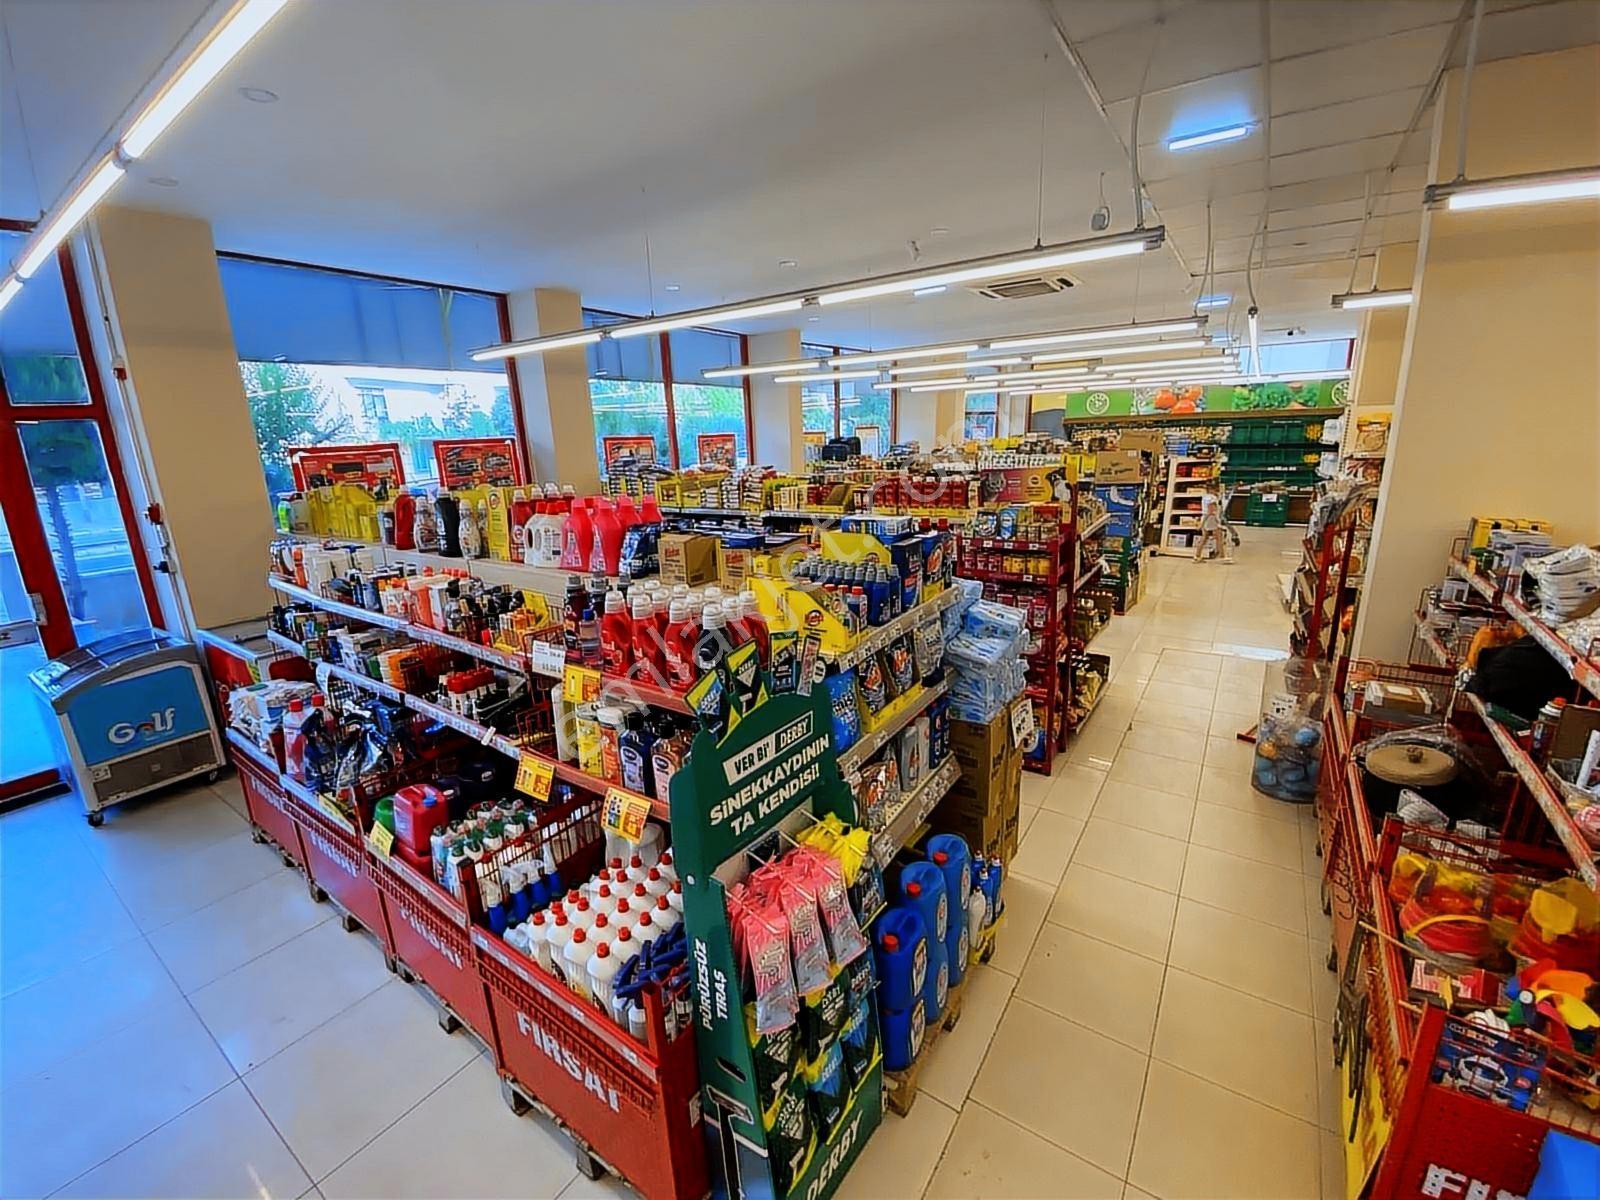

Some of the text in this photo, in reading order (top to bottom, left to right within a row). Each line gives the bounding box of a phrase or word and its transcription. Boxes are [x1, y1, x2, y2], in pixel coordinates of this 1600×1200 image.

[108, 707, 176, 744] Golf
[734, 755, 756, 775] VER
[780, 718, 810, 749] DERBY
[730, 811, 756, 837] TA
[694, 938, 714, 1031] PÜRÜZSÜZ
[713, 968, 729, 1020] TIRAŞ
[807, 1109, 864, 1200] DERBY
